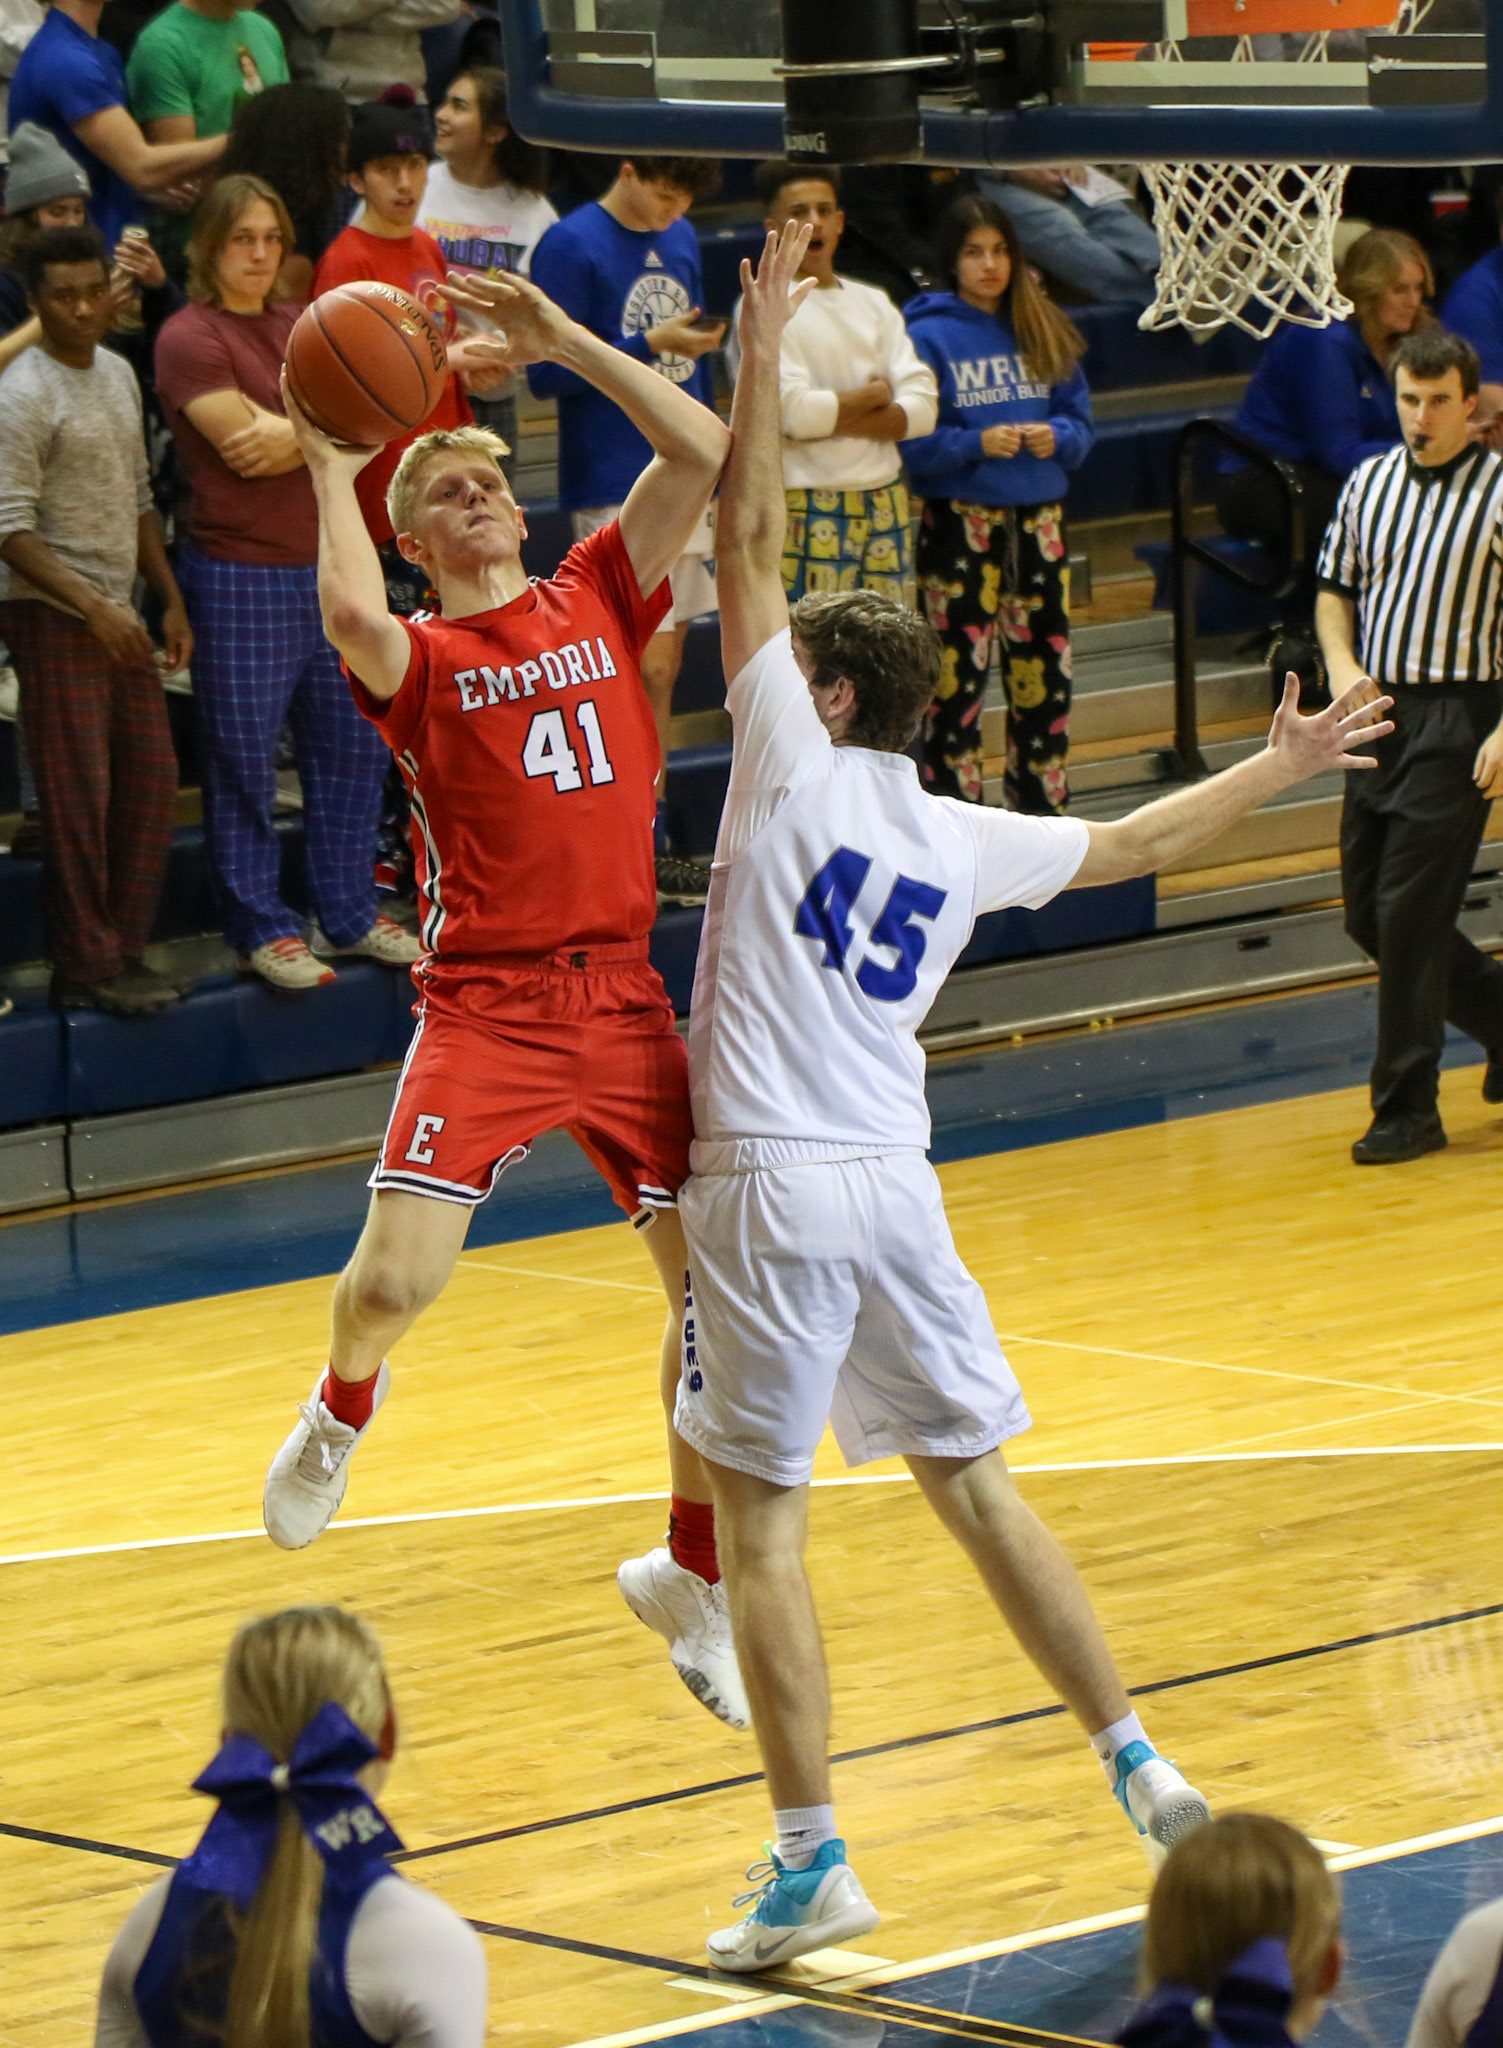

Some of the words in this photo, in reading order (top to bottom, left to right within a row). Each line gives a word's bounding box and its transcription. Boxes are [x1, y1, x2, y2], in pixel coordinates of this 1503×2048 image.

[454, 637, 617, 712] EMPORIA
[521, 698, 615, 793] 41
[793, 844, 948, 1004] 45
[404, 1113, 446, 1166] E
[316, 1806, 386, 1850] WR
